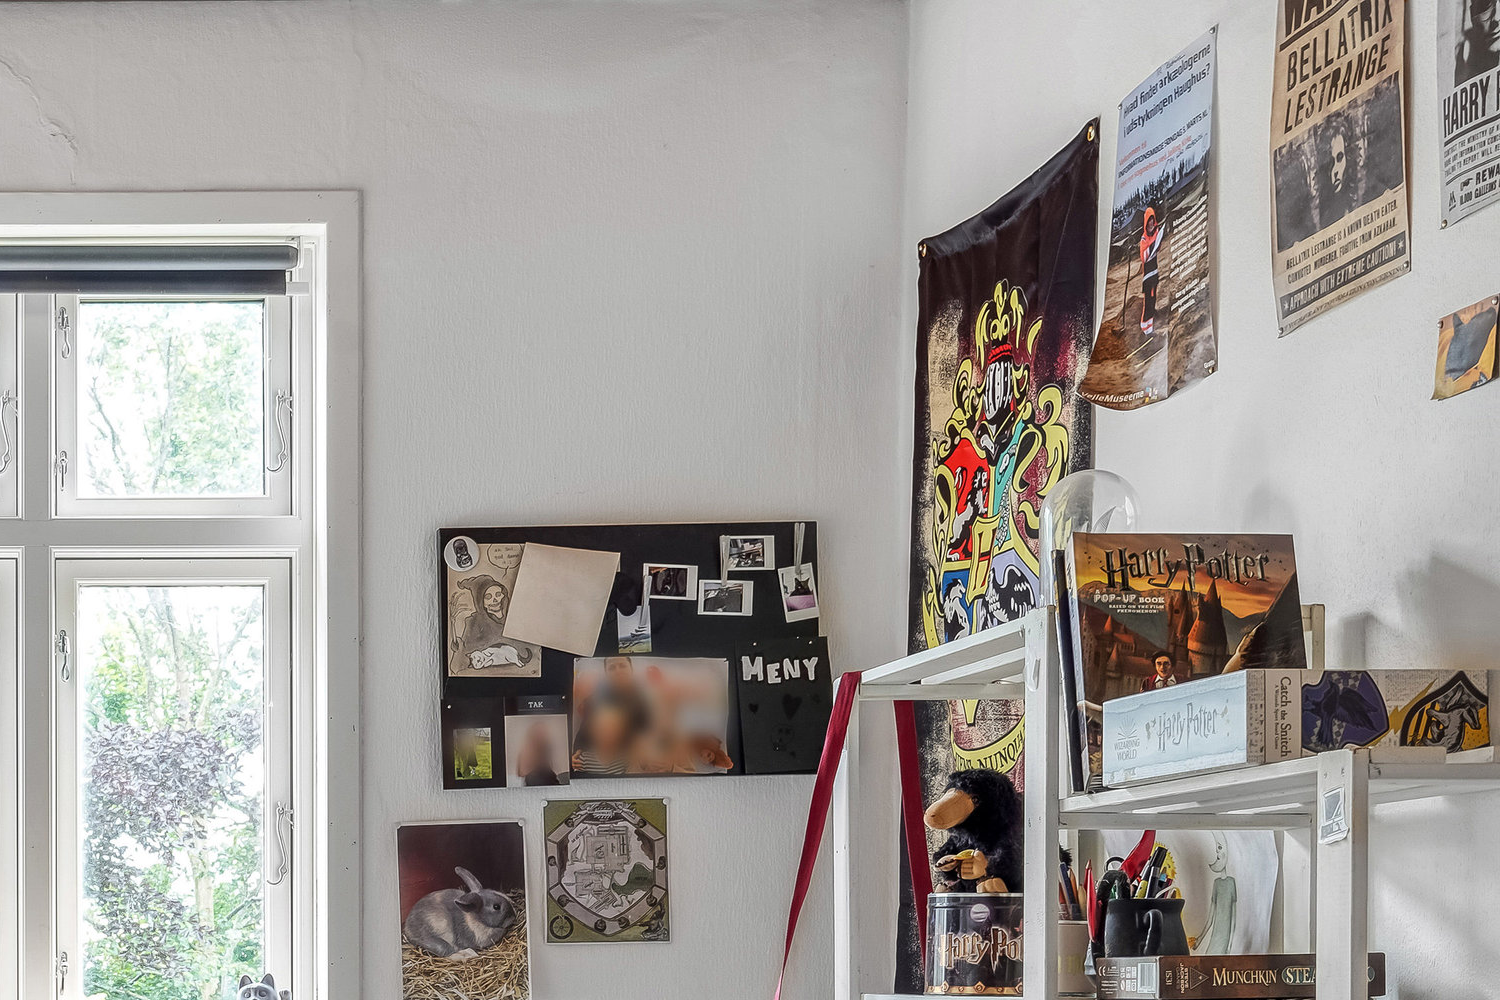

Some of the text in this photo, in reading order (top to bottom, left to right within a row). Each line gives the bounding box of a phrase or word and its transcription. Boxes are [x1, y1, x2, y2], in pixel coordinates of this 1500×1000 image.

[1287, 0, 1393, 92] BELLATRIX
[1284, 34, 1391, 134] LESTRANGE
[1443, 75, 1491, 139] HARRY
[1475, 163, 1500, 187] REWA
[1363, 208, 1380, 227] DEATH
[1336, 258, 1366, 286] EXTREME
[1100, 543, 1270, 592] Harry Potter
[1093, 594, 1137, 604] POP-UP
[741, 655, 819, 684] MENY
[528, 700, 544, 708] TAK
[1280, 676, 1292, 758] Catch the Snitch
[1155, 702, 1219, 752] Harry Potter
[1114, 738, 1141, 751] WIZARDING
[1116, 749, 1138, 761] WORLD
